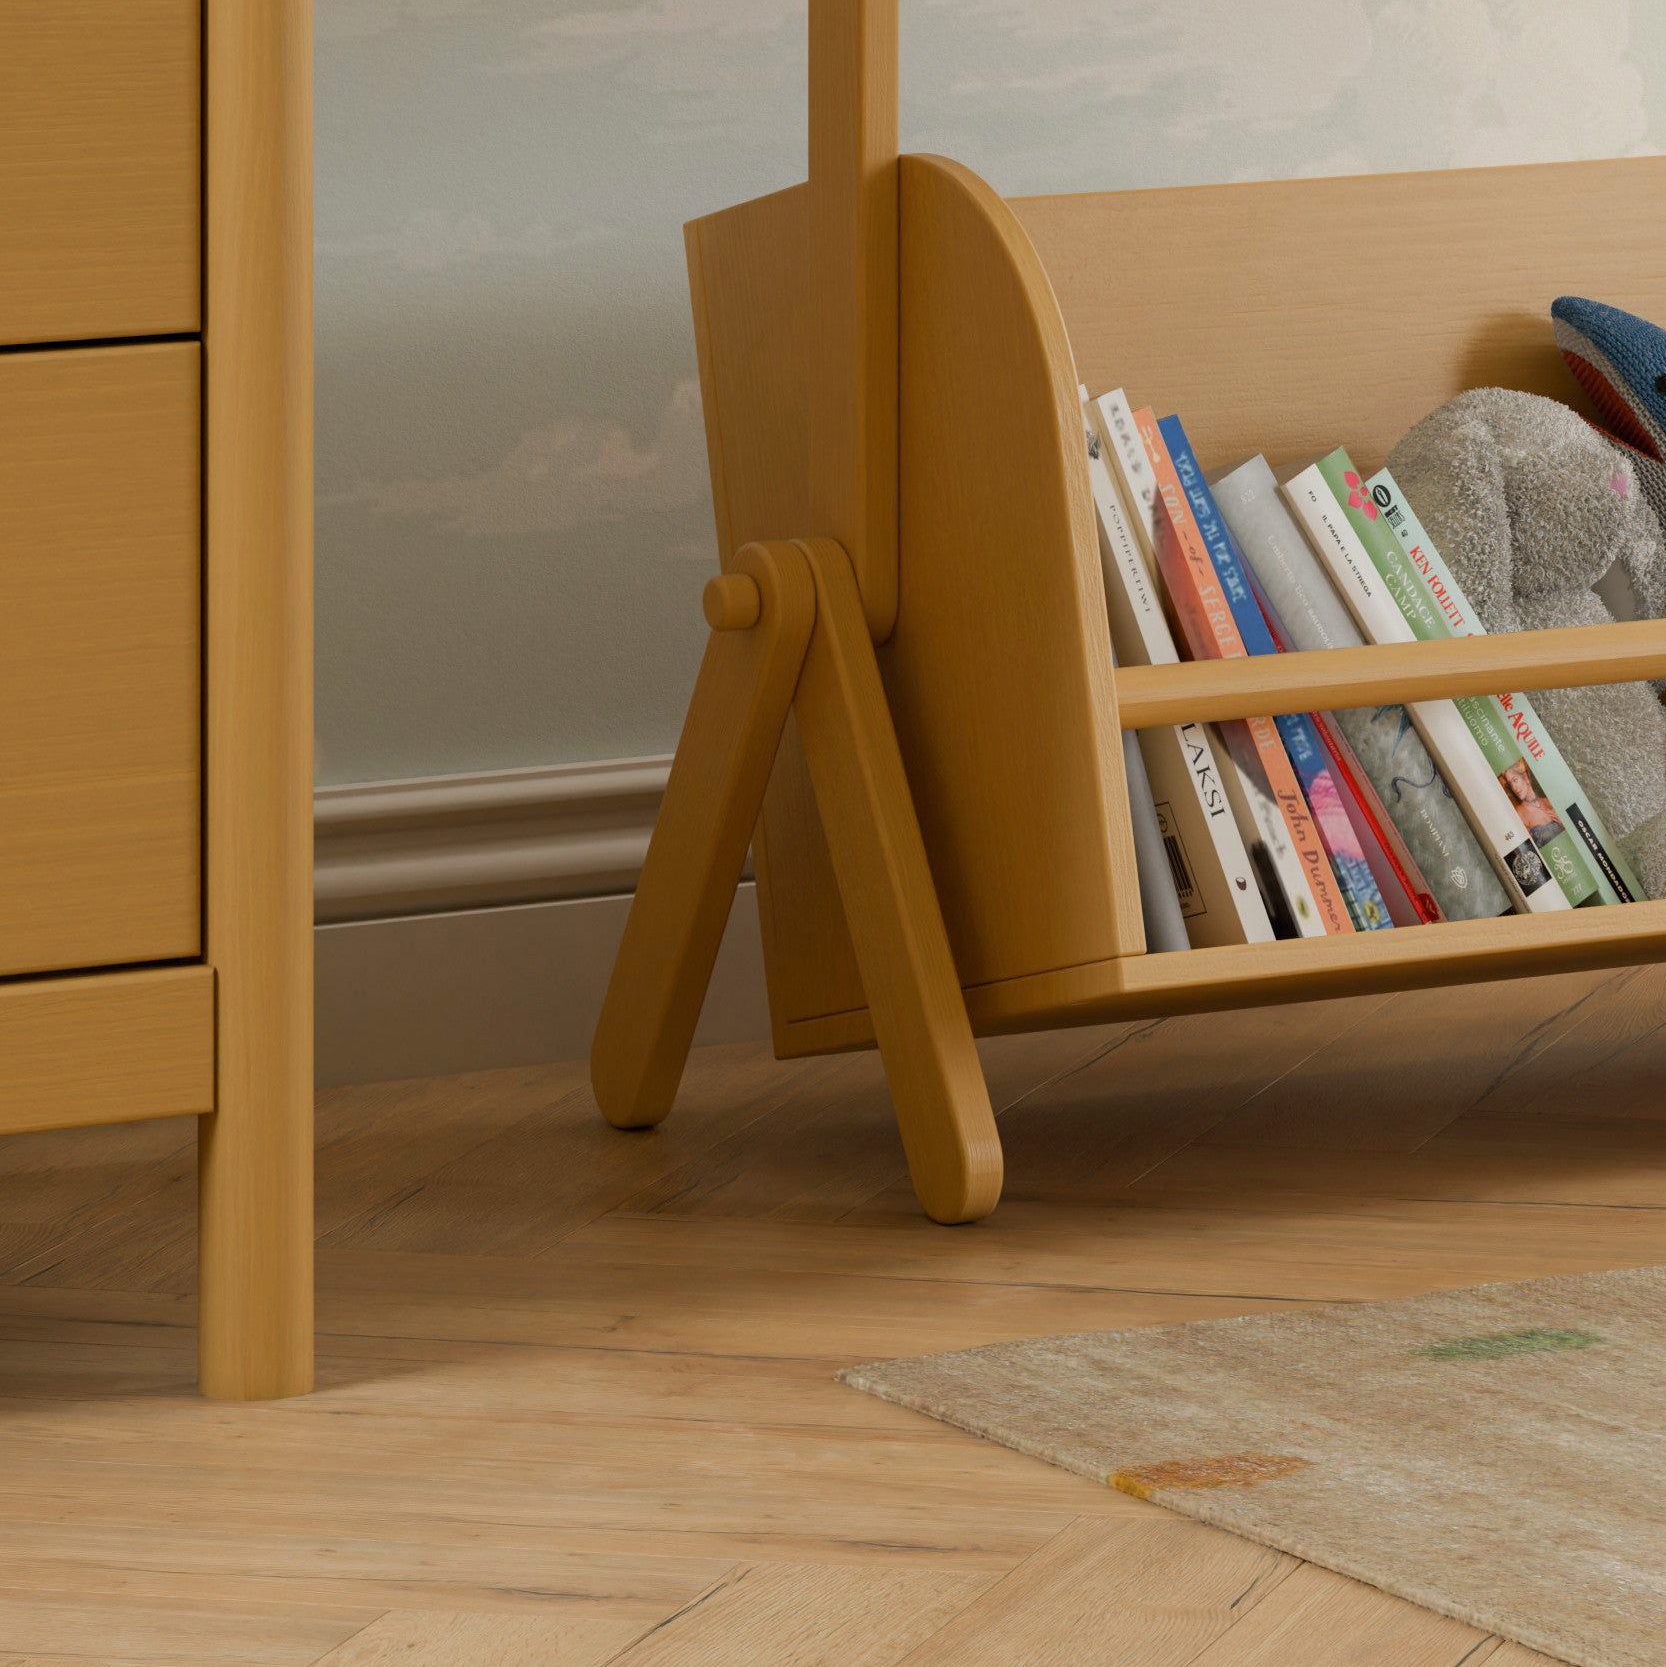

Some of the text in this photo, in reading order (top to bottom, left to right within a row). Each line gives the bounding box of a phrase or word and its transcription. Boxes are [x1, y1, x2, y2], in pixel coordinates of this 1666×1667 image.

[1327, 524, 1341, 546] PAPA
[1345, 553, 1353, 564] LA
[1352, 565, 1372, 598] STREGA
[1385, 573, 1417, 619] CAMP
[1386, 551, 1436, 629] CANDACE
[1410, 545, 1466, 628] KEN FOLLETT
[1508, 712, 1545, 762] AQUILE
[1278, 789, 1309, 842] John
[1302, 849, 1341, 931] Dummer
[1578, 820, 1598, 850] OSCAR
